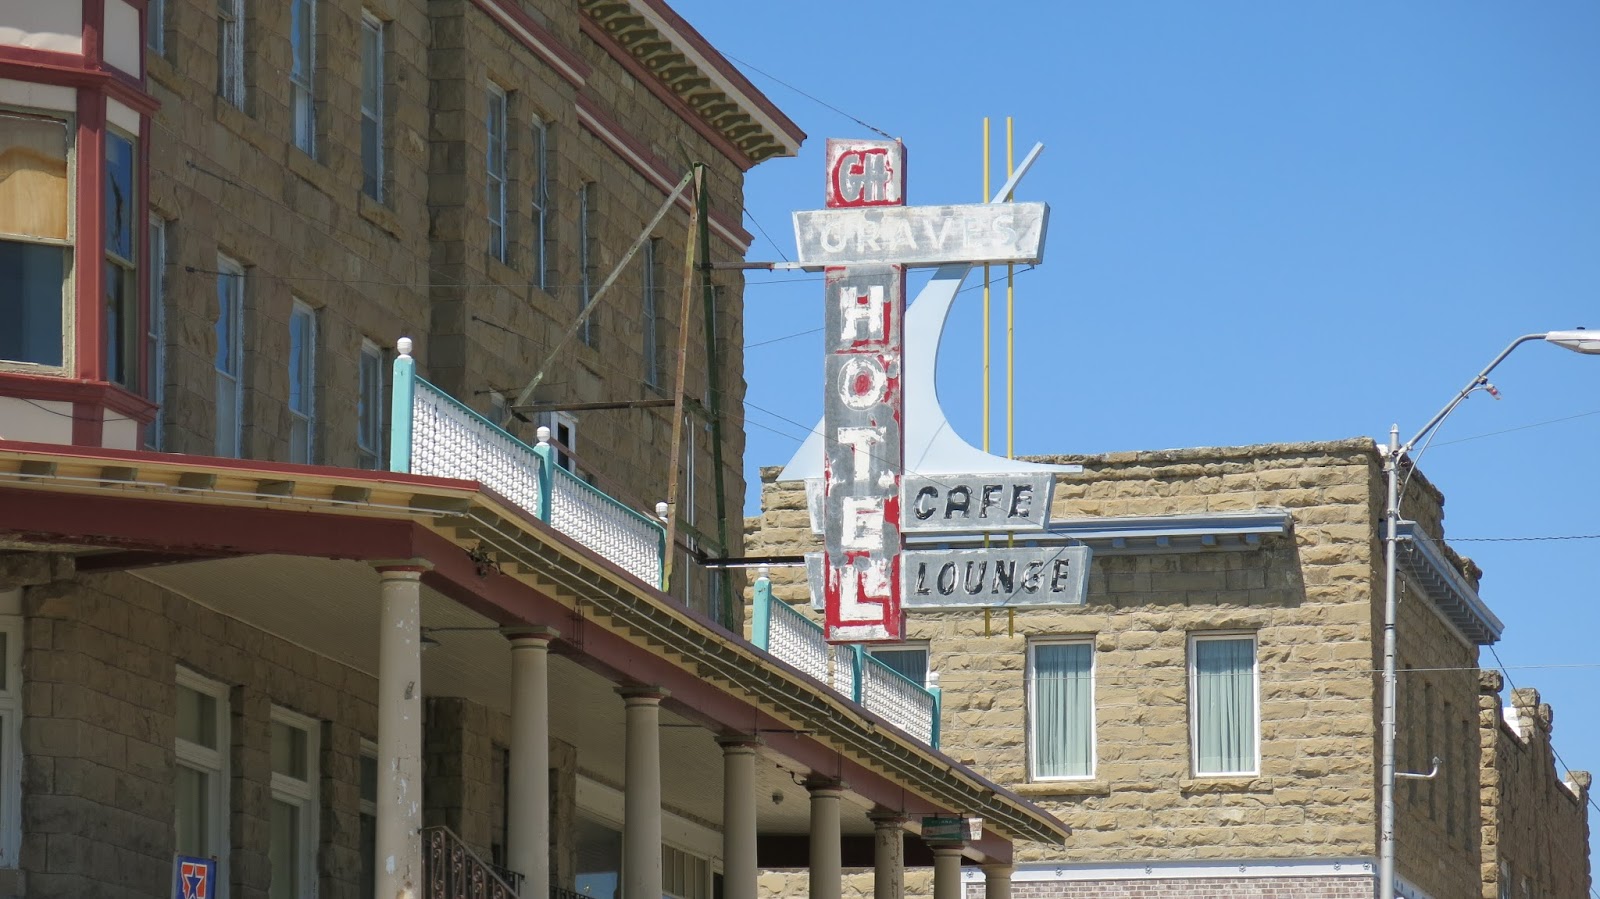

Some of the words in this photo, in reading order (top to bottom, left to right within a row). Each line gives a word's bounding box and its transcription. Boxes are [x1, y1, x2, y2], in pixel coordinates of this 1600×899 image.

[820, 215, 1018, 253] GRAVES
[838, 285, 888, 622] HOTEL
[913, 484, 1034, 520] CAFE
[914, 558, 1071, 596] LOUNGE
